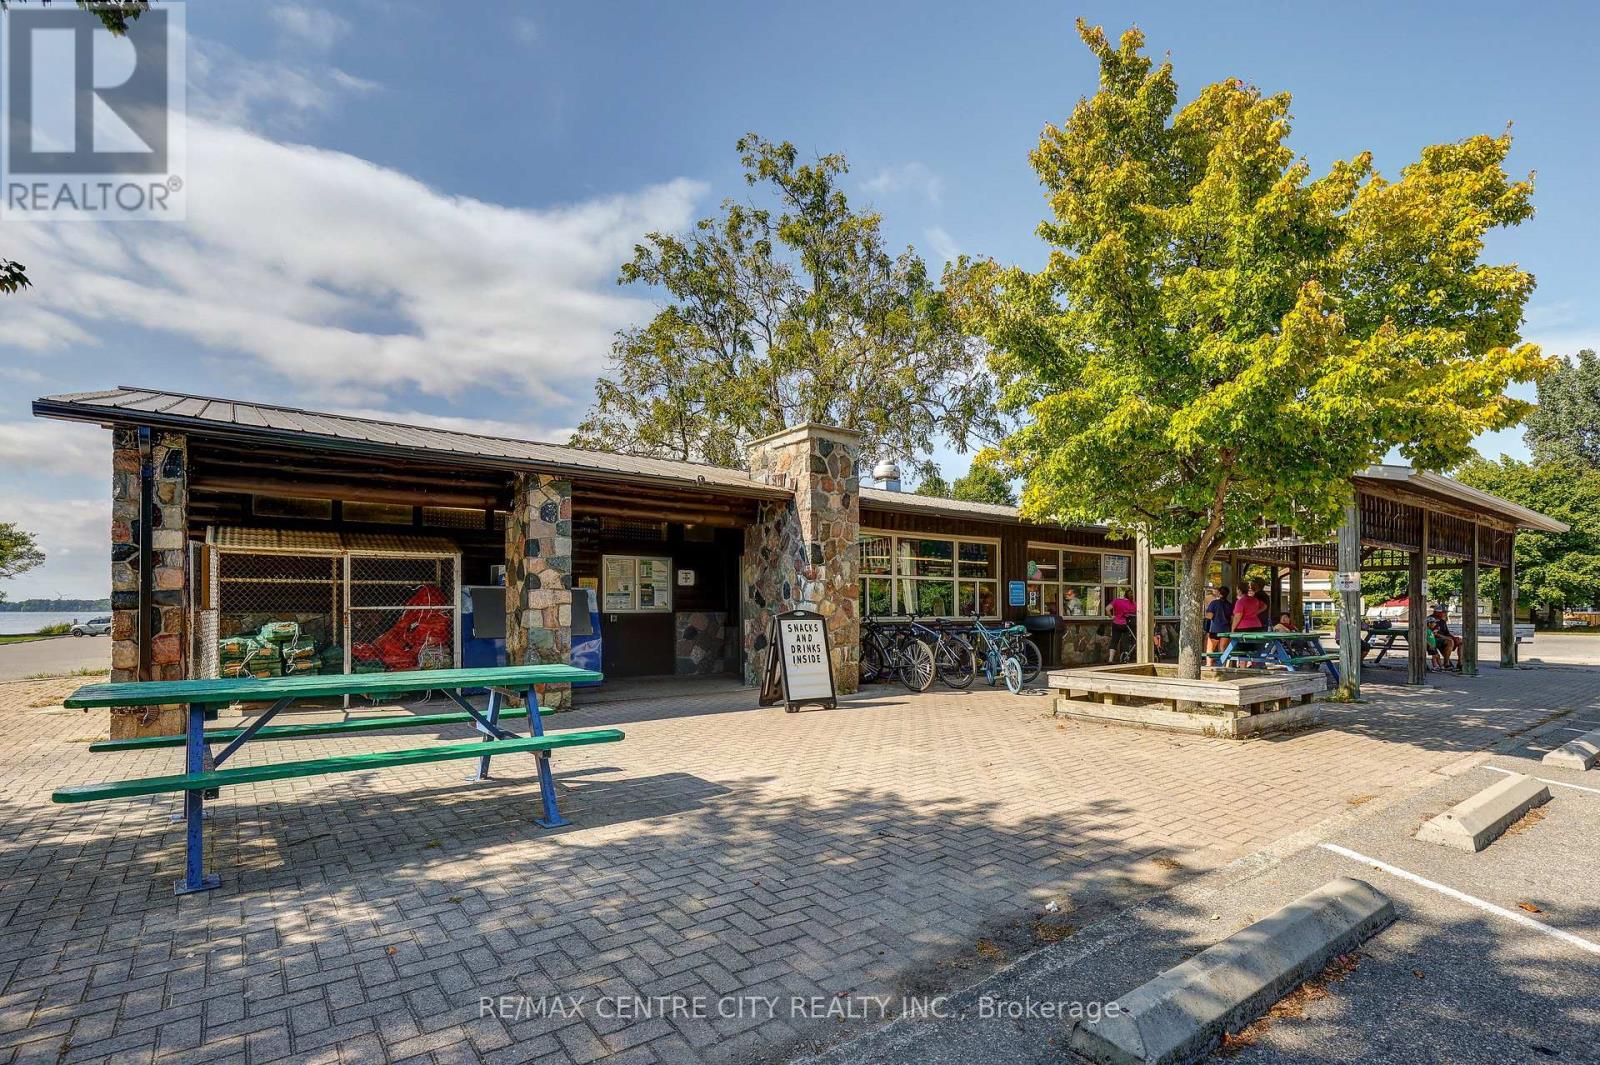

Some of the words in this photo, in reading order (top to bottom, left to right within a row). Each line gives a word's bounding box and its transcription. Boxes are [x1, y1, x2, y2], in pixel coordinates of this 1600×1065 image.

[787, 623, 819, 633] SNACKS
[796, 634, 813, 643] AND
[791, 644, 821, 654] DRINKS
[792, 654, 821, 664] INSIDE
